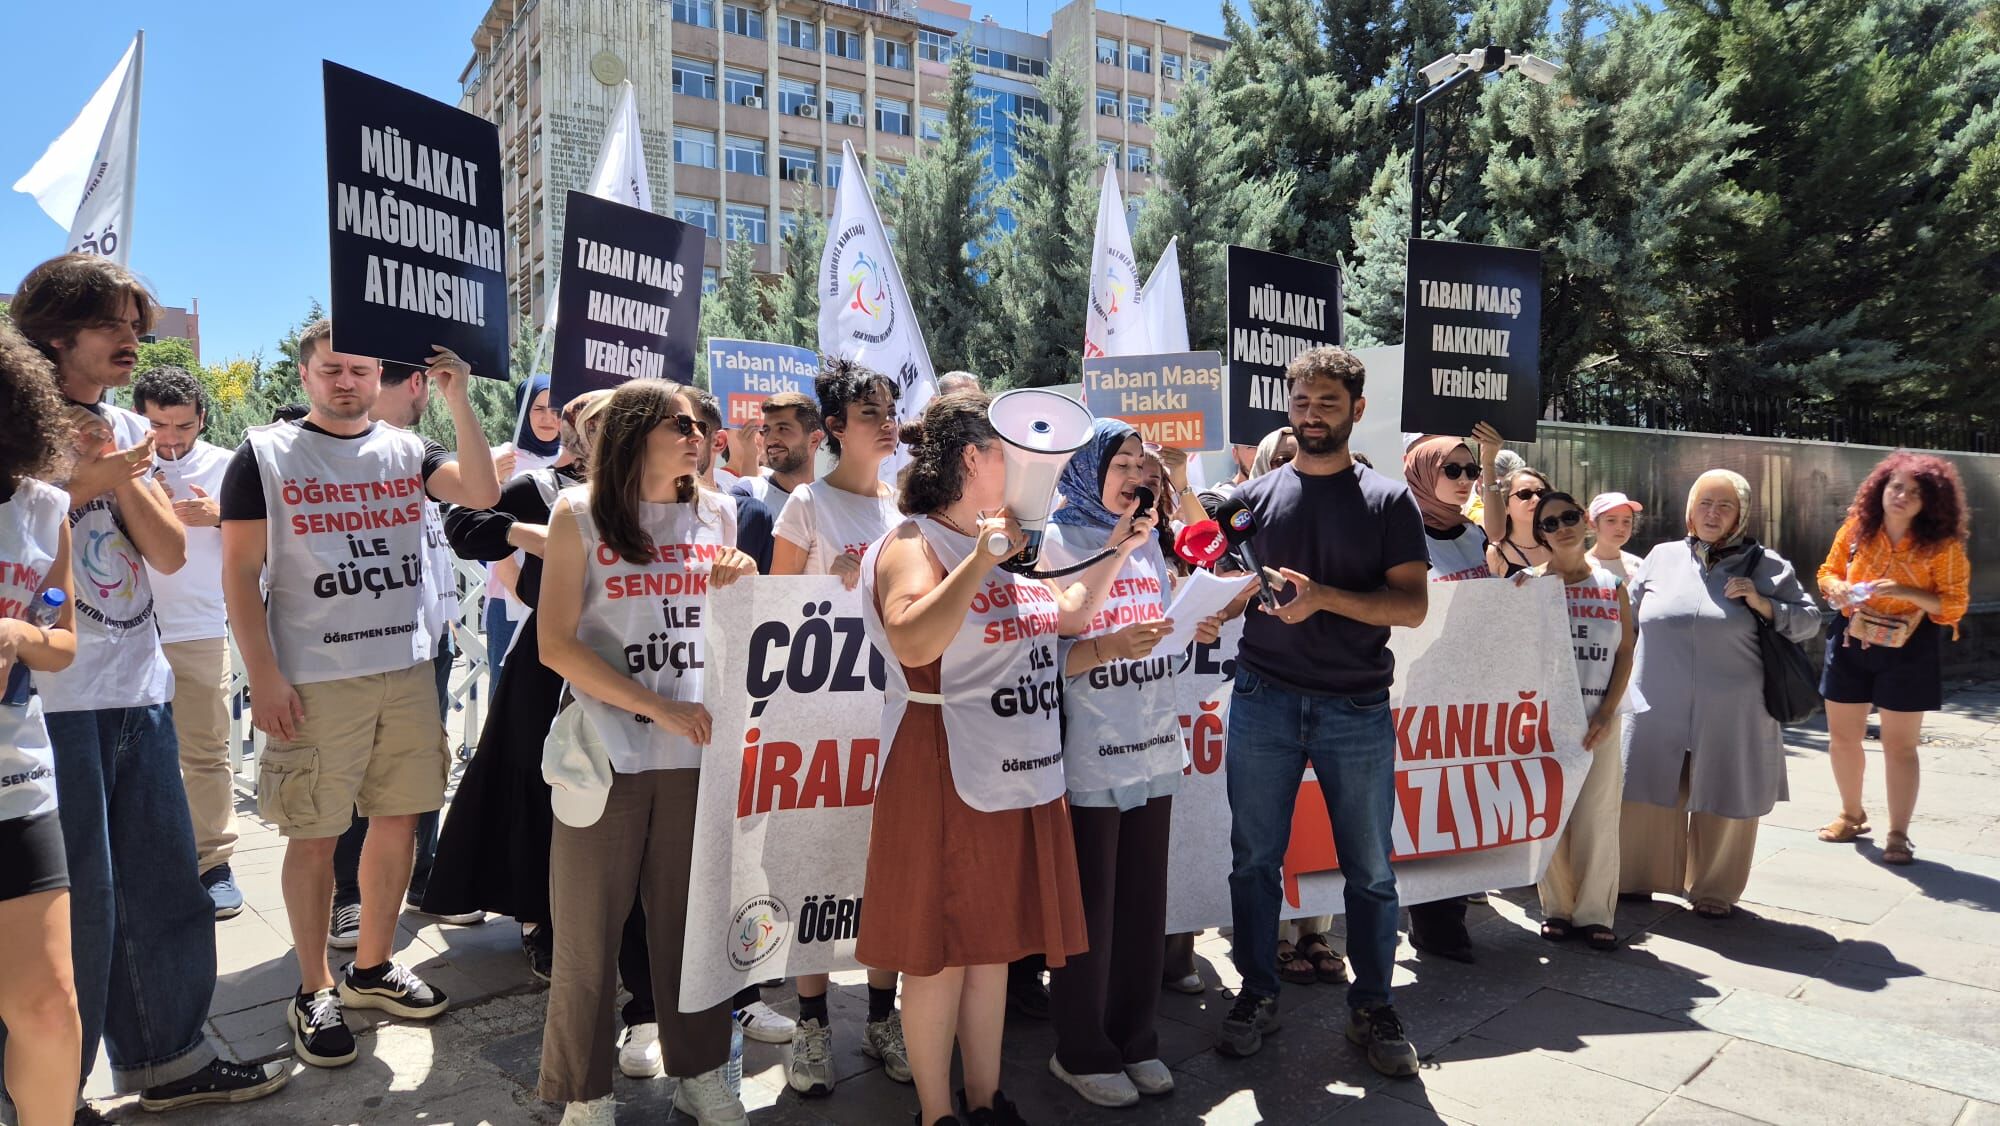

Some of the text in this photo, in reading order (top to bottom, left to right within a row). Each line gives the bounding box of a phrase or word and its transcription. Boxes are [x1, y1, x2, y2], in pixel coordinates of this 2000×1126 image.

[361, 125, 478, 207] MÜLAKAT
[337, 182, 501, 273] MAĞDURLARI
[578, 237, 635, 281] TABAN
[637, 253, 684, 297] MAAŞ
[364, 254, 485, 327] ATANSIN!
[1249, 283, 1327, 331] MÜLAKAT
[1420, 279, 1522, 319] TABAN MAAŞ
[587, 290, 670, 337] HAKKIMIZ
[1432, 324, 1510, 358] HAKKIMIZ
[712, 350, 774, 372] Taban
[744, 373, 799, 393] Hakkı
[1086, 366, 1221, 391] Taban Maaş
[1431, 365, 1508, 401] VERİLSİN!
[732, 399, 765, 420] HE
[1121, 388, 1187, 412] Hakkı
[282, 473, 423, 506] ÖĞRETMEN
[292, 502, 422, 535] SENDİKAS
[348, 534, 390, 558] İLE
[1204, 532, 1224, 555] NOW
[313, 553, 424, 599] GÜÇLÜ!
[663, 598, 701, 629] İLE
[323, 628, 383, 644] ÖĞRETMEN
[1575, 643, 1608, 661] LÜ!
[1029, 640, 1054, 671] İLE
[991, 674, 1060, 720] GÜÇL
[1002, 755, 1052, 773] ÖĞRETMEN
